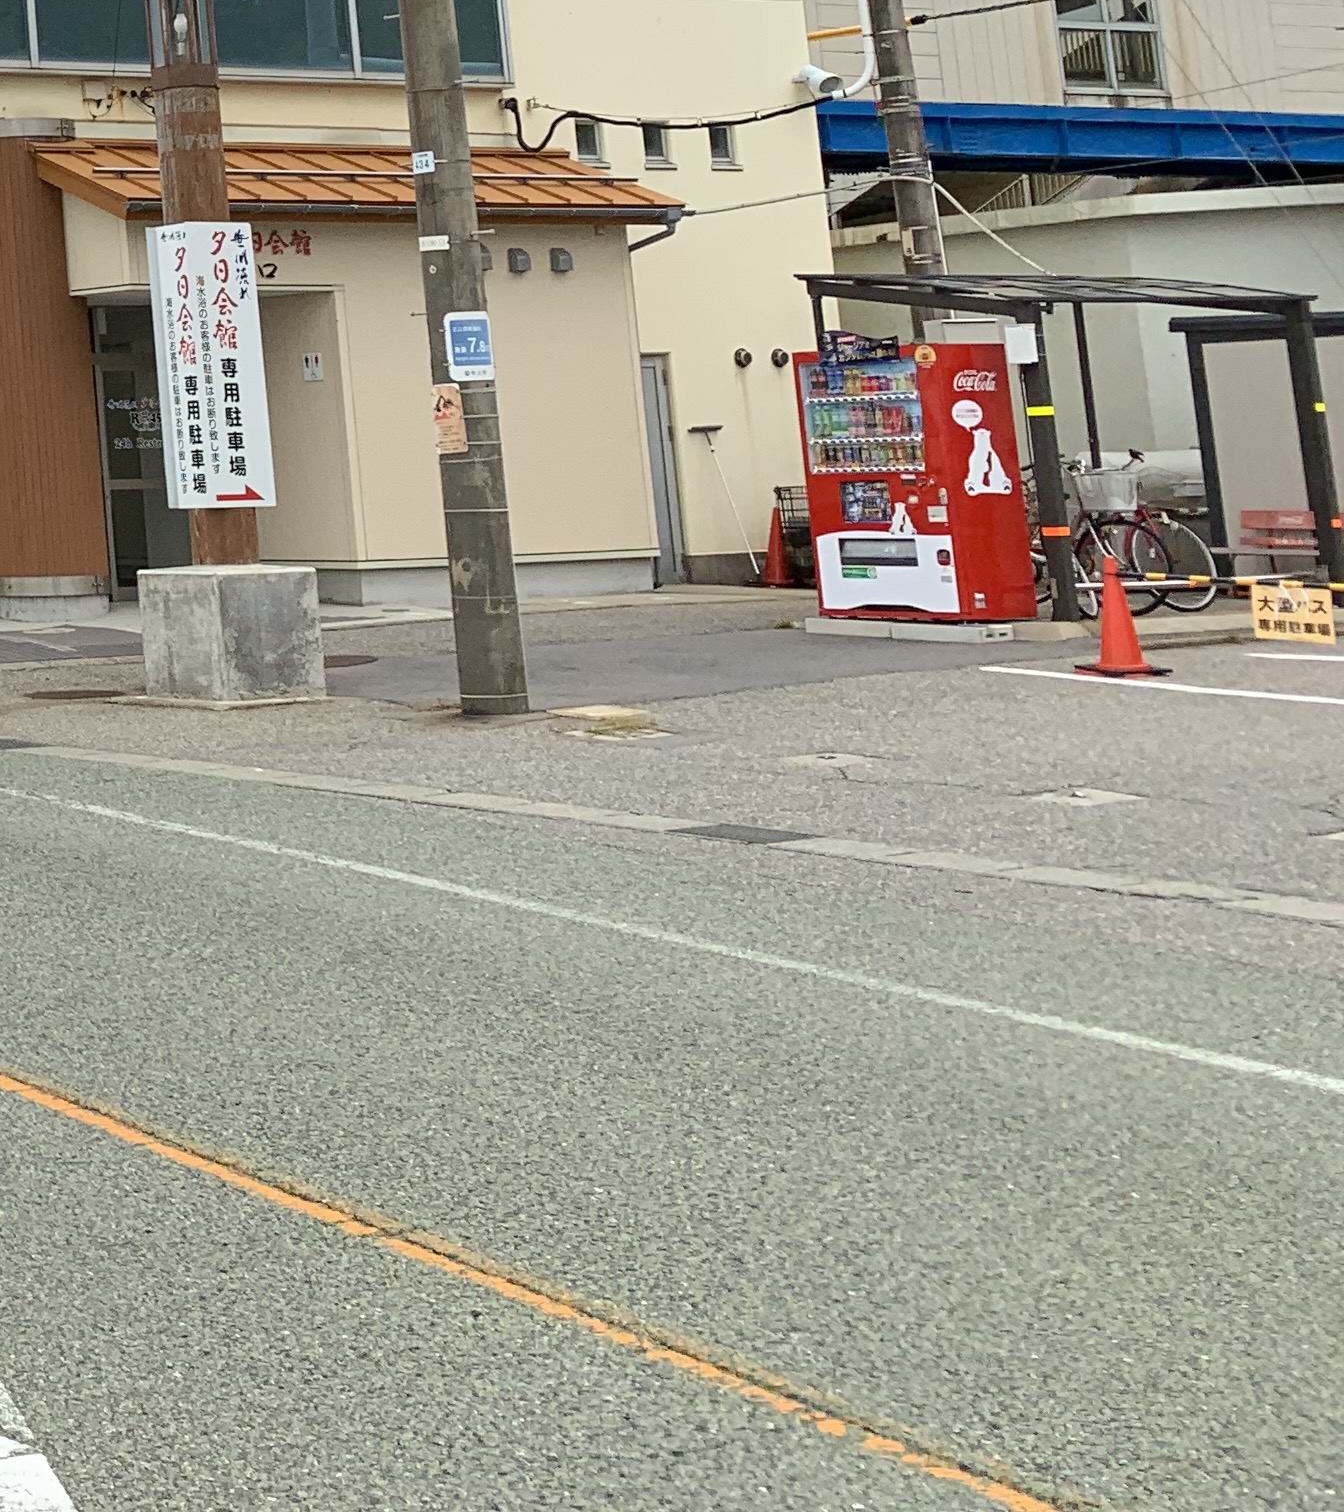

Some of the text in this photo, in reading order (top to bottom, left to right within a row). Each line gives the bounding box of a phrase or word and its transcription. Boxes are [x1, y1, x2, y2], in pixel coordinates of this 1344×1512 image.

[174, 246, 207, 494] 夕日会館 専用駐車場
[210, 231, 247, 477] 夕日会館 専用駐車場
